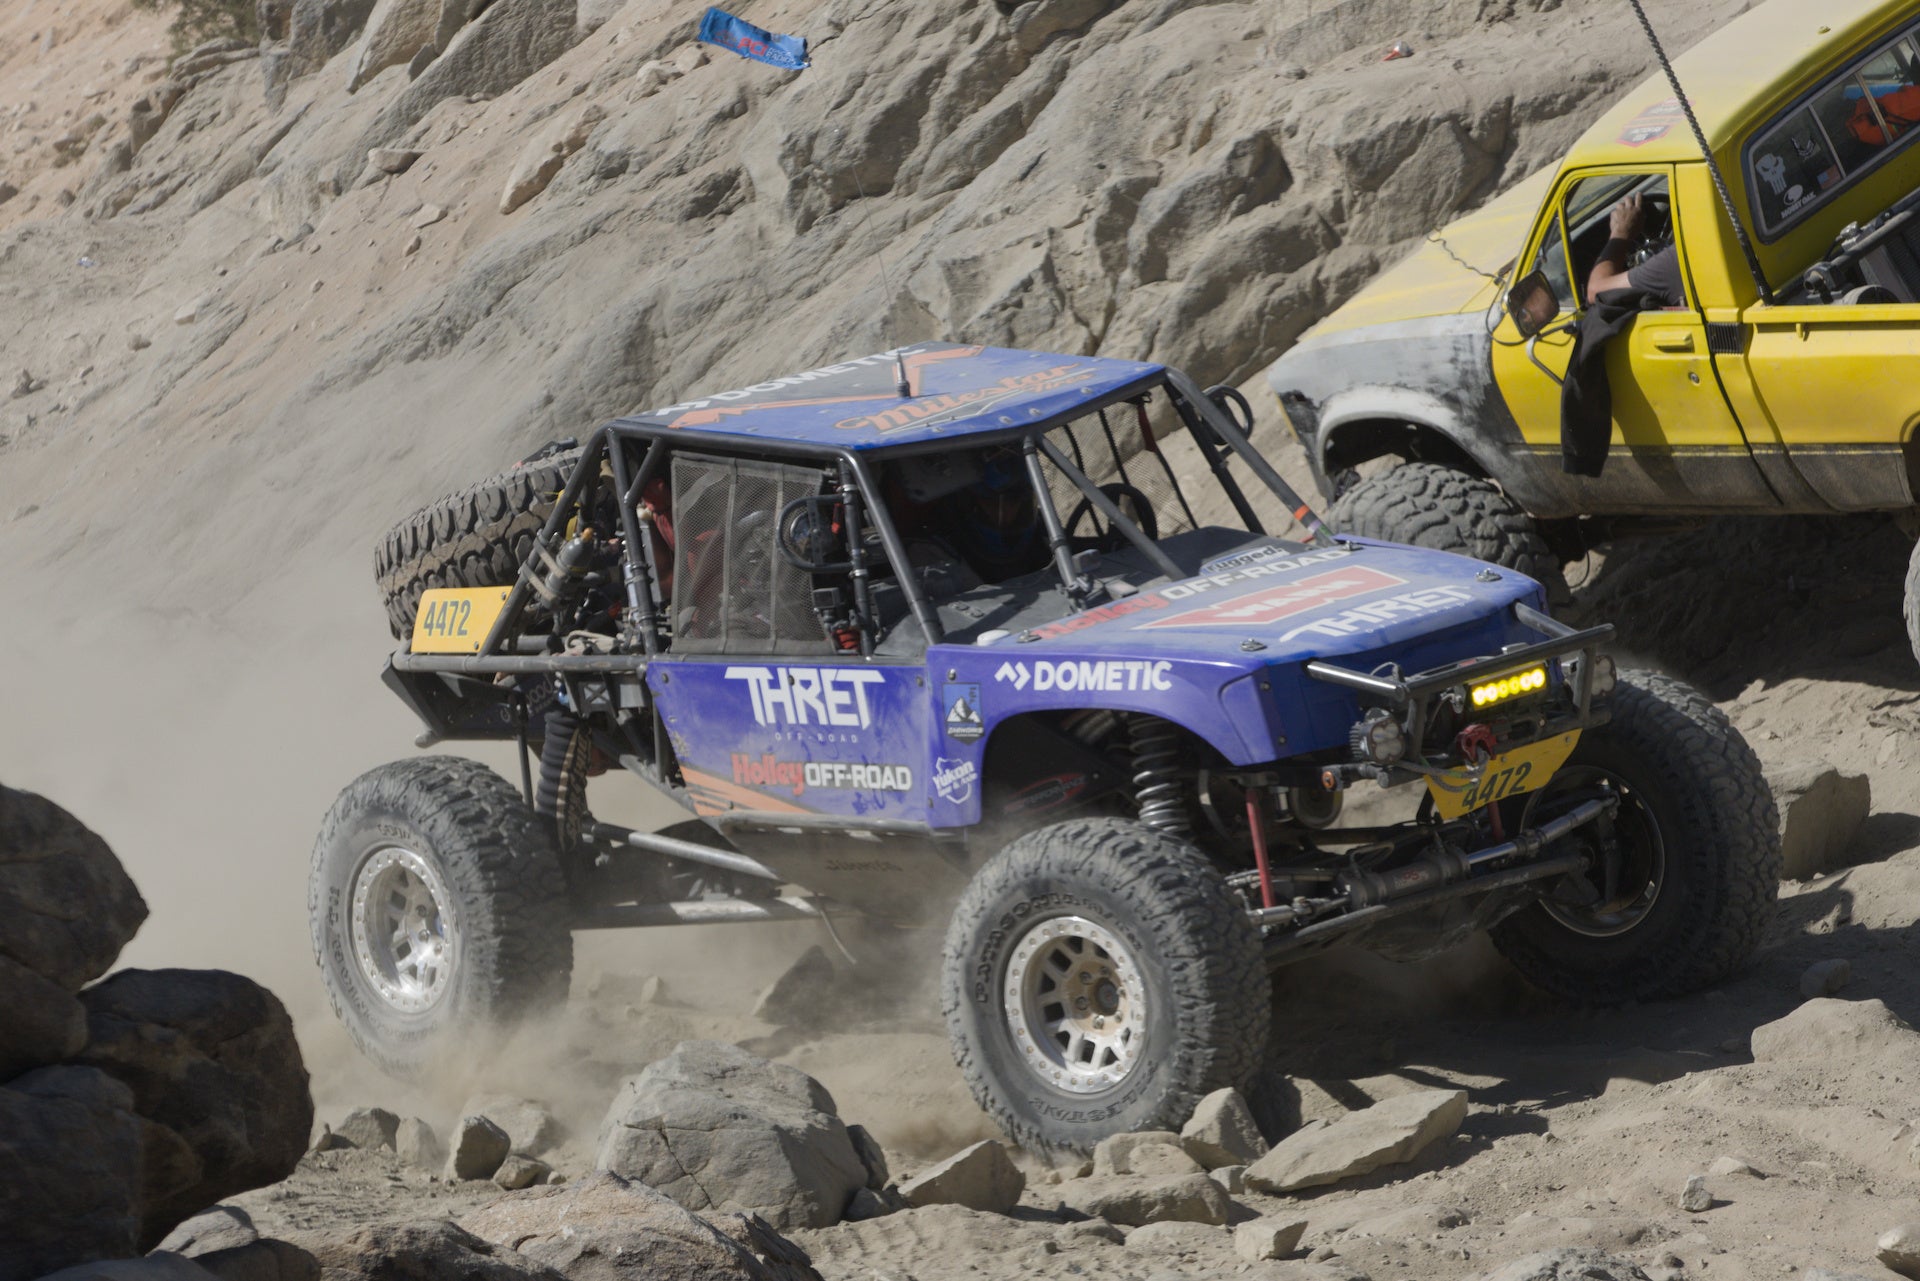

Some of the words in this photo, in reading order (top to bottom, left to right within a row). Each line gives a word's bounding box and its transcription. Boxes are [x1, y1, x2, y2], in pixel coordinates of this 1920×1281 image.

[737, 37, 769, 56] PCI
[834, 363, 1079, 431] Milestar
[1032, 594, 1170, 640] Holley
[1160, 549, 1351, 601] OFF-ROAD
[1279, 585, 1473, 643] THRET
[422, 599, 472, 637] 4472
[724, 666, 886, 731] THRET
[1034, 660, 1173, 692] DOMETIC
[774, 731, 859, 744] OFF-ROAD
[731, 752, 805, 797] Holley
[804, 762, 913, 791] OFF-ROAD
[932, 761, 974, 789] Yukon
[1461, 761, 1533, 811] 4472
